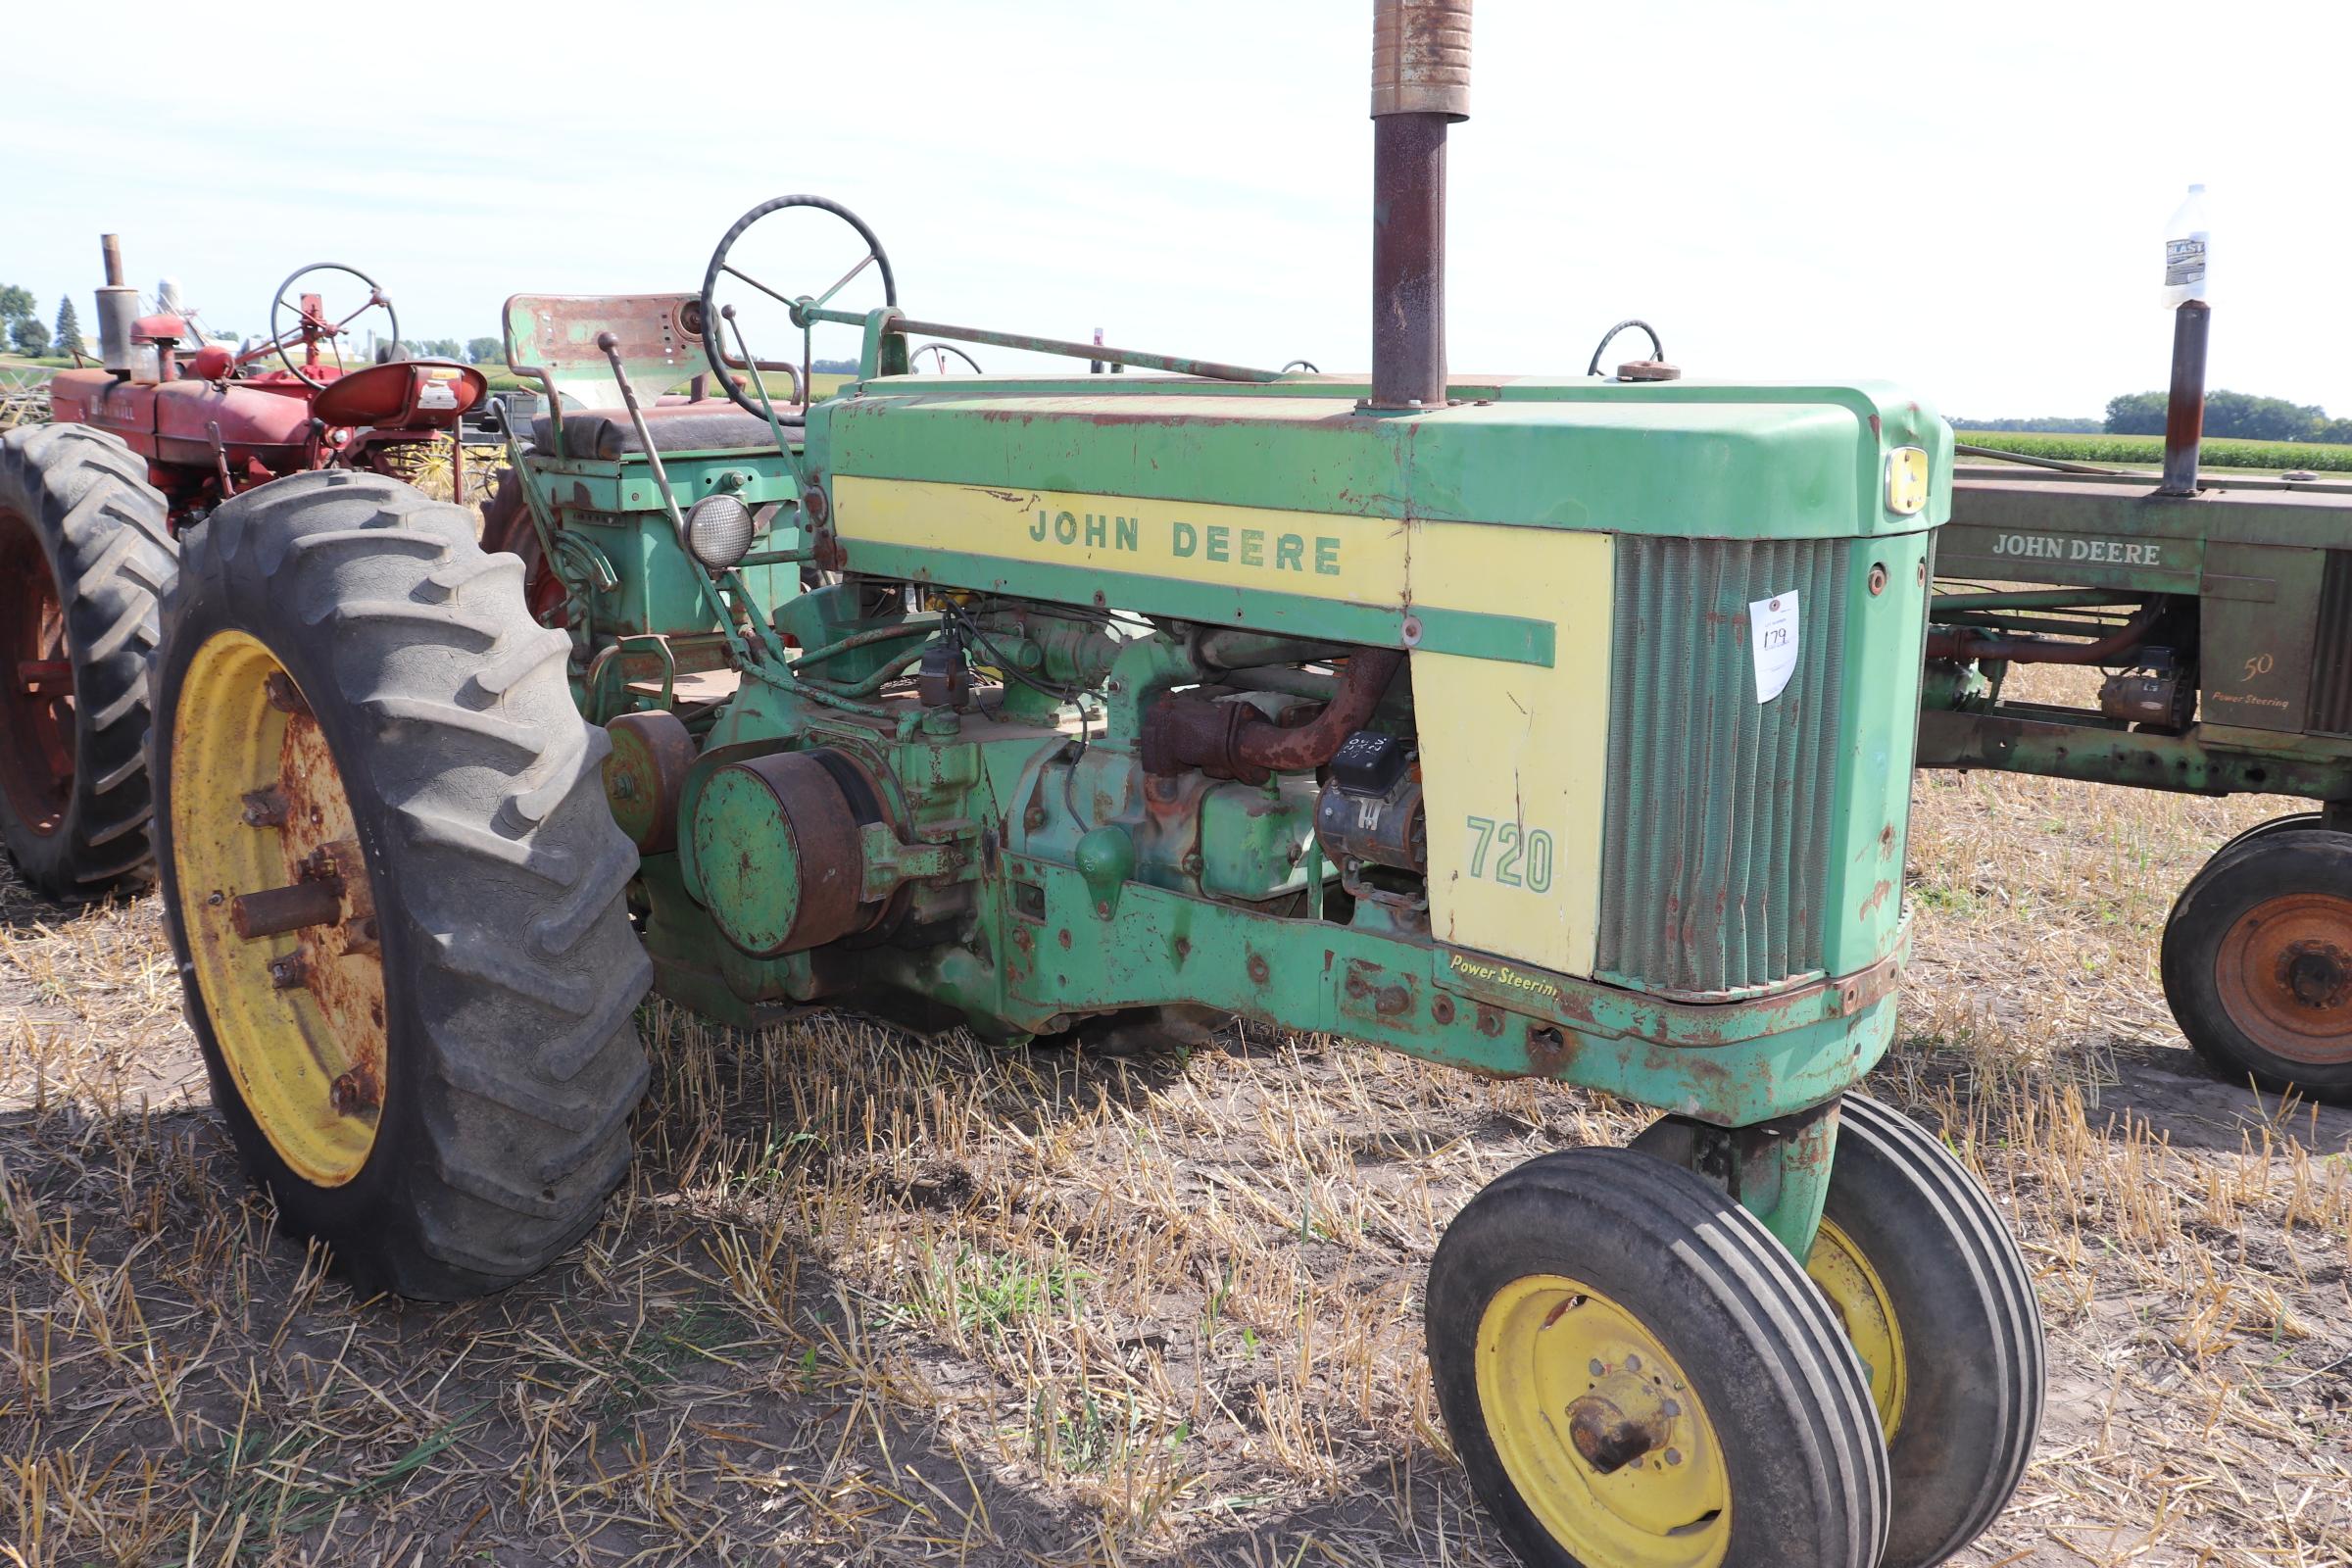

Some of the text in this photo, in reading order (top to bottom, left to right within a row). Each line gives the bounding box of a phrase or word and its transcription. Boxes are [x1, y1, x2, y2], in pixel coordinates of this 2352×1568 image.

[1029, 510, 1342, 576] JOHN DEERE
[1992, 534, 2162, 565] JOHN DEERE
[1764, 627, 1788, 649] 179
[2240, 653, 2274, 682] 50
[2212, 691, 2290, 710] Power Steering
[1467, 814, 1553, 894] 720
[1450, 955, 1496, 980] Power
